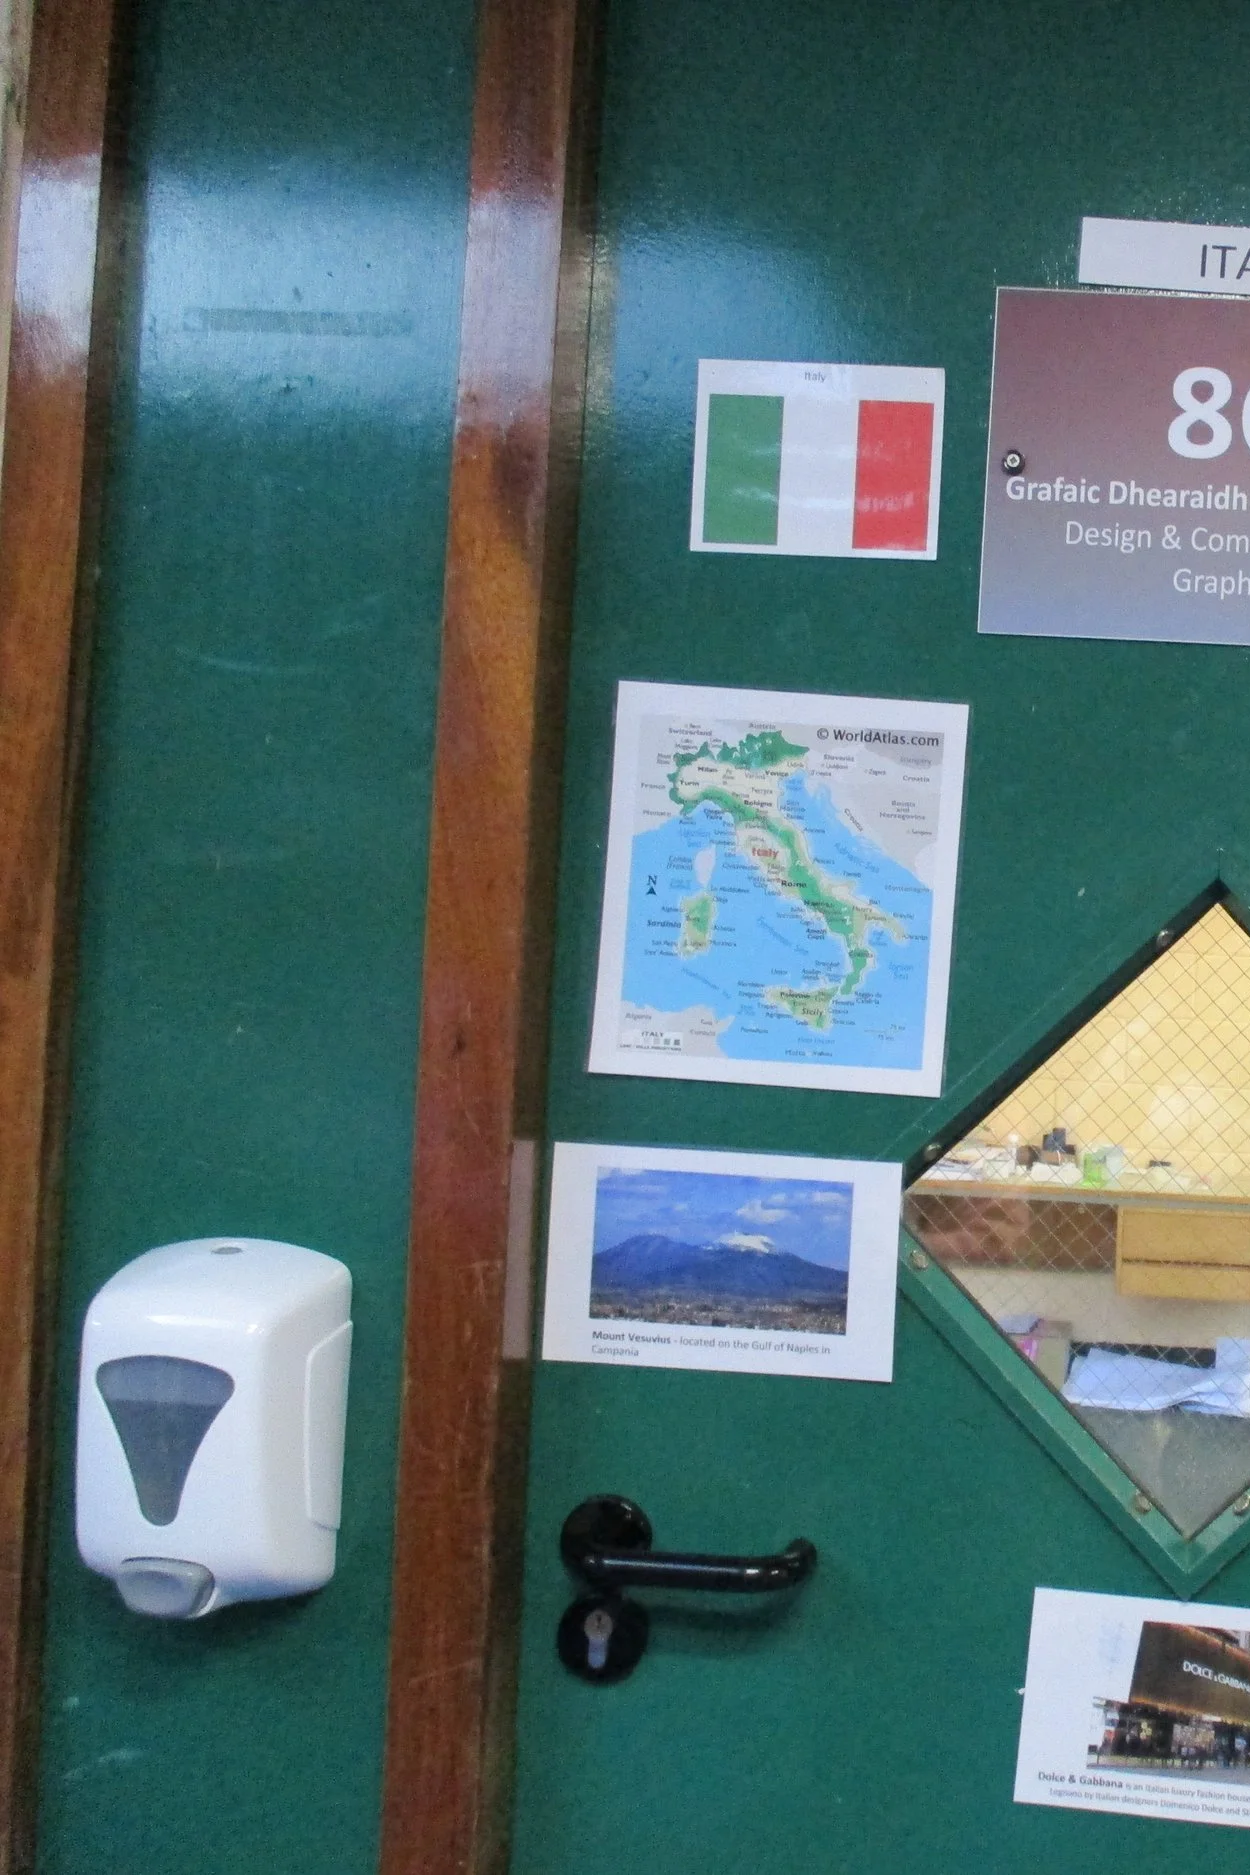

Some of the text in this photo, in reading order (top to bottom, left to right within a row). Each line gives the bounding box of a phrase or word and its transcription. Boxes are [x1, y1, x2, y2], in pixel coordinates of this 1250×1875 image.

[804, 371, 826, 383] Italy
[1006, 476, 1100, 504] Grafaic
[1109, 480, 1247, 511] Dhearaidh
[1065, 520, 1151, 554] Design
[1161, 524, 1182, 551] &
[833, 729, 940, 747] WorldAtlas.com
[591, 1330, 625, 1342] Mount
[628, 1332, 671, 1345] Vesuvius
[680, 1336, 715, 1348] located
[718, 1340, 730, 1349] on
[733, 1340, 749, 1351] the
[751, 1340, 772, 1352] Gulf
[774, 1341, 784, 1352] of
[786, 1343, 819, 1356] Naples
[821, 1345, 831, 1355] in
[591, 1345, 639, 1358] Campania
[1183, 1660, 1213, 1680] DOLCE
[1038, 1771, 1065, 1783] Dolce
[1068, 1773, 1076, 1784] &
[1079, 1774, 1124, 1789] Gabbana
